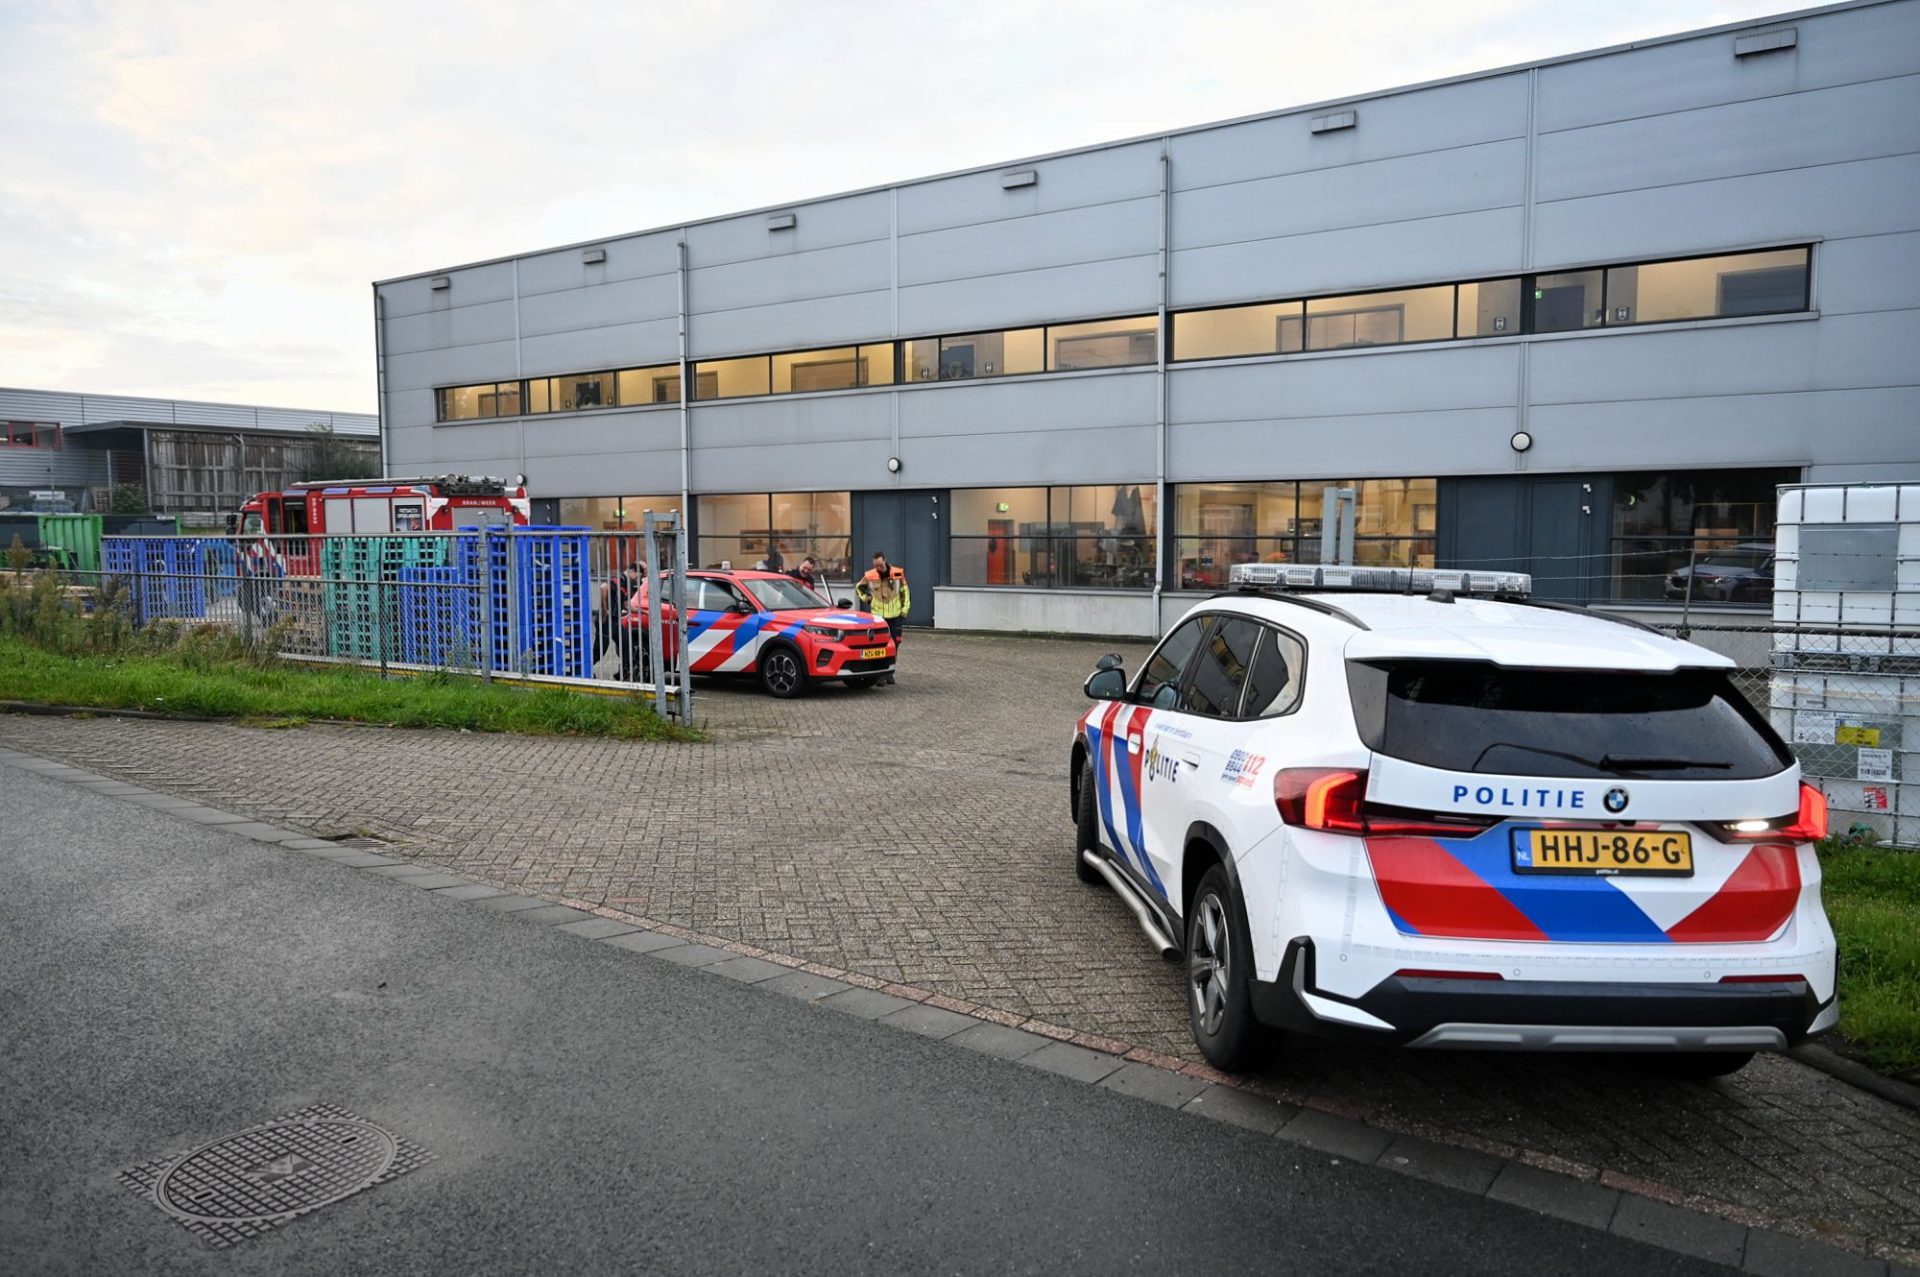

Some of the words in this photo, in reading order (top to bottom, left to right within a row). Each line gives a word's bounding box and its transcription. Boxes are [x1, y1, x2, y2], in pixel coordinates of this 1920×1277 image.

[1144, 748, 1179, 782] POLITIE
[1242, 754, 1267, 775] 112
[1453, 785, 1585, 808] POLITIE
[1517, 851, 1530, 861] NL
[1540, 834, 1681, 864] HHJ-86-G
